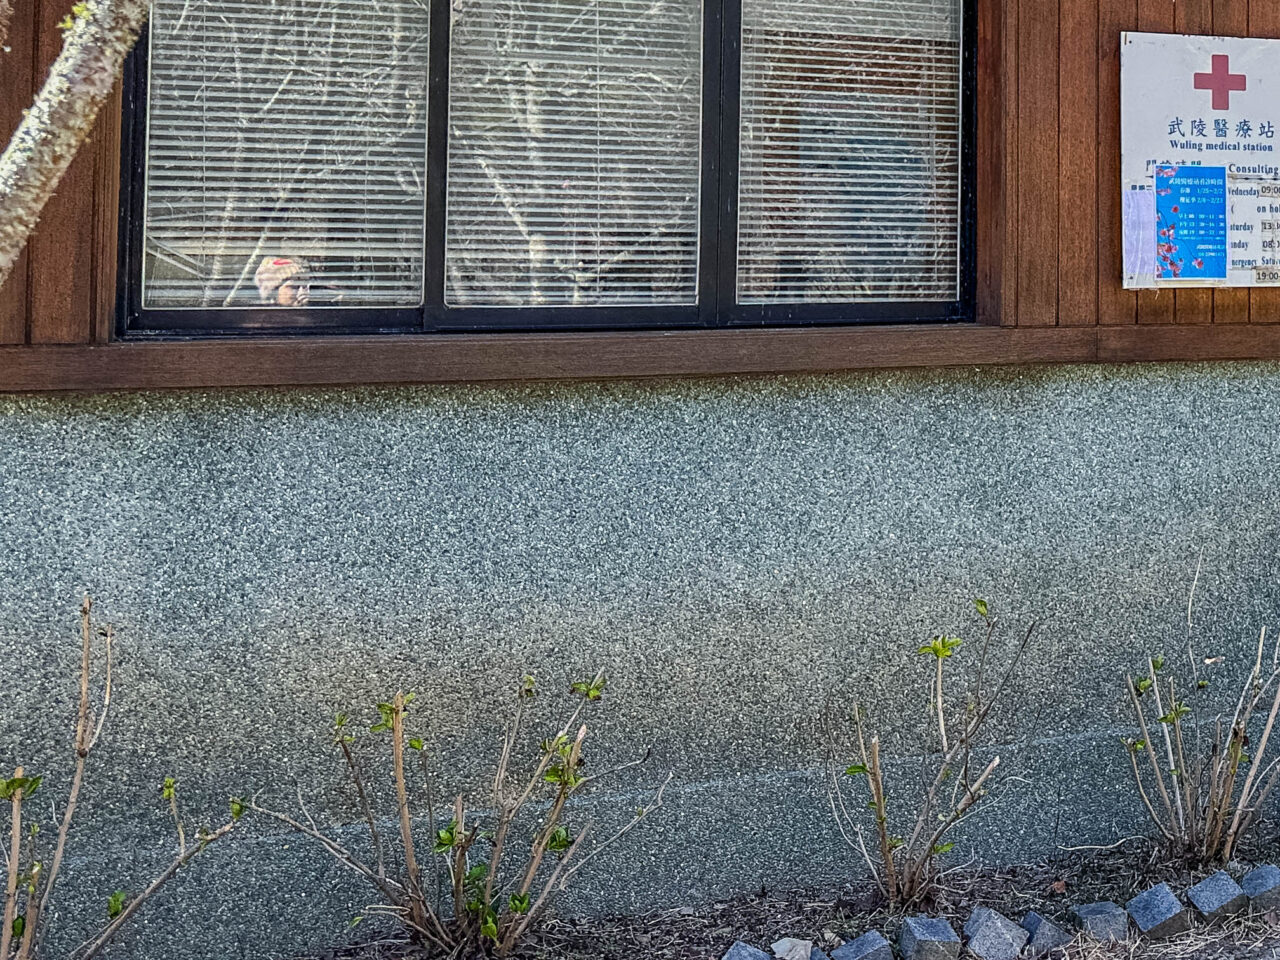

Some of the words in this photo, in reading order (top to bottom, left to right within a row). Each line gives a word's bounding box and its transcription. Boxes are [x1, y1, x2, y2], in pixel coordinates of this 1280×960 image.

[1167, 116, 1275, 139] 武陵醫療站
[1169, 139, 1203, 152] Wuling
[1205, 140, 1240, 151] medical
[1243, 141, 1273, 152] station
[1228, 163, 1279, 177] Consulting
[1256, 205, 1266, 213] on
[1230, 222, 1254, 233] turday
[1231, 240, 1249, 251] nday
